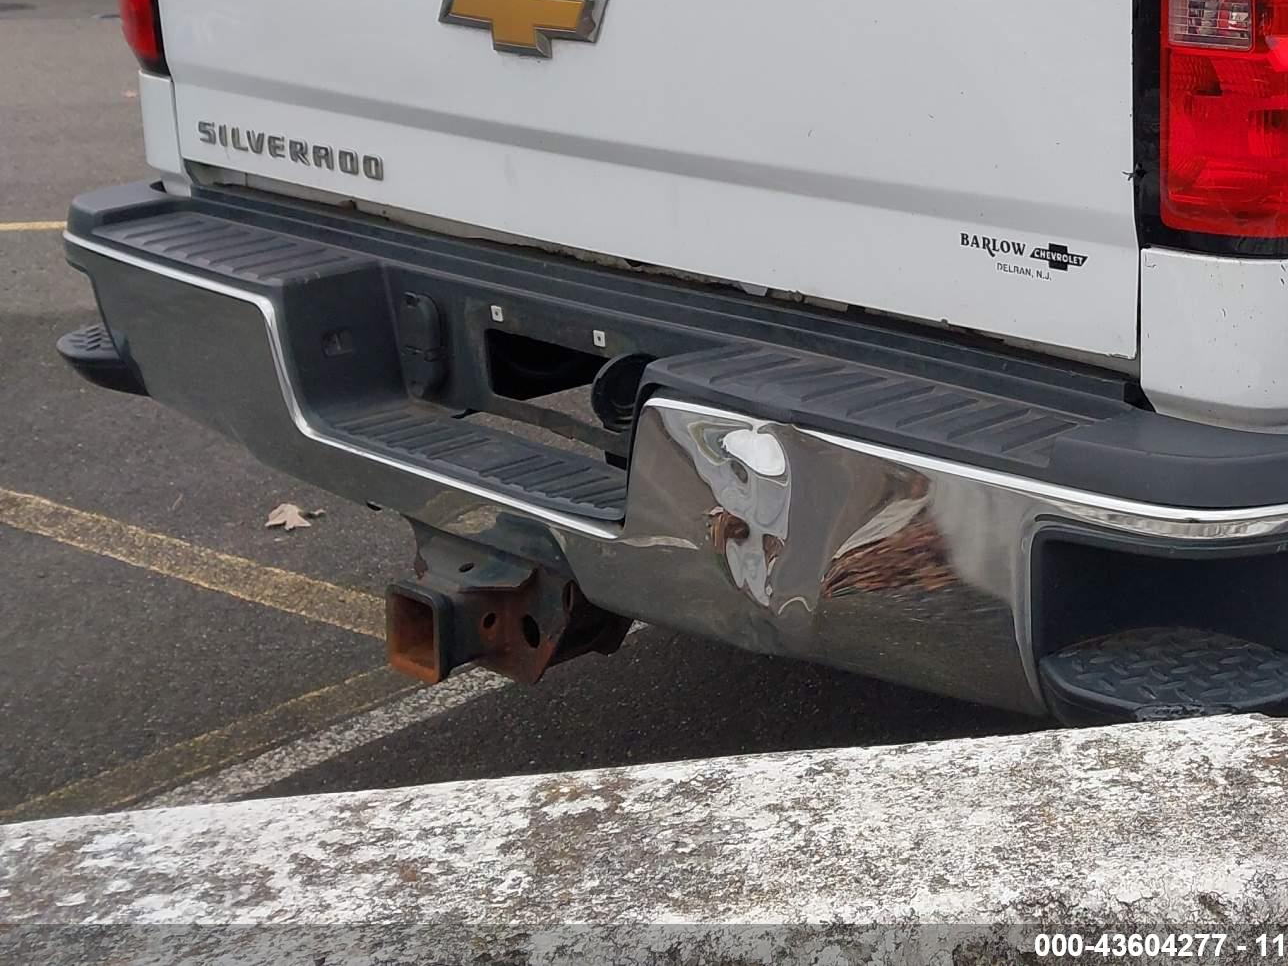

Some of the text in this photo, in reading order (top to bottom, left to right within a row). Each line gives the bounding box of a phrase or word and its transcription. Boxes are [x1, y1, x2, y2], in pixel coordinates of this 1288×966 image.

[198, 121, 384, 181] SILVERADO
[960, 233, 1084, 266] BARLOW CHEVROLET
[996, 262, 1052, 281] DELRAN, N.J.
